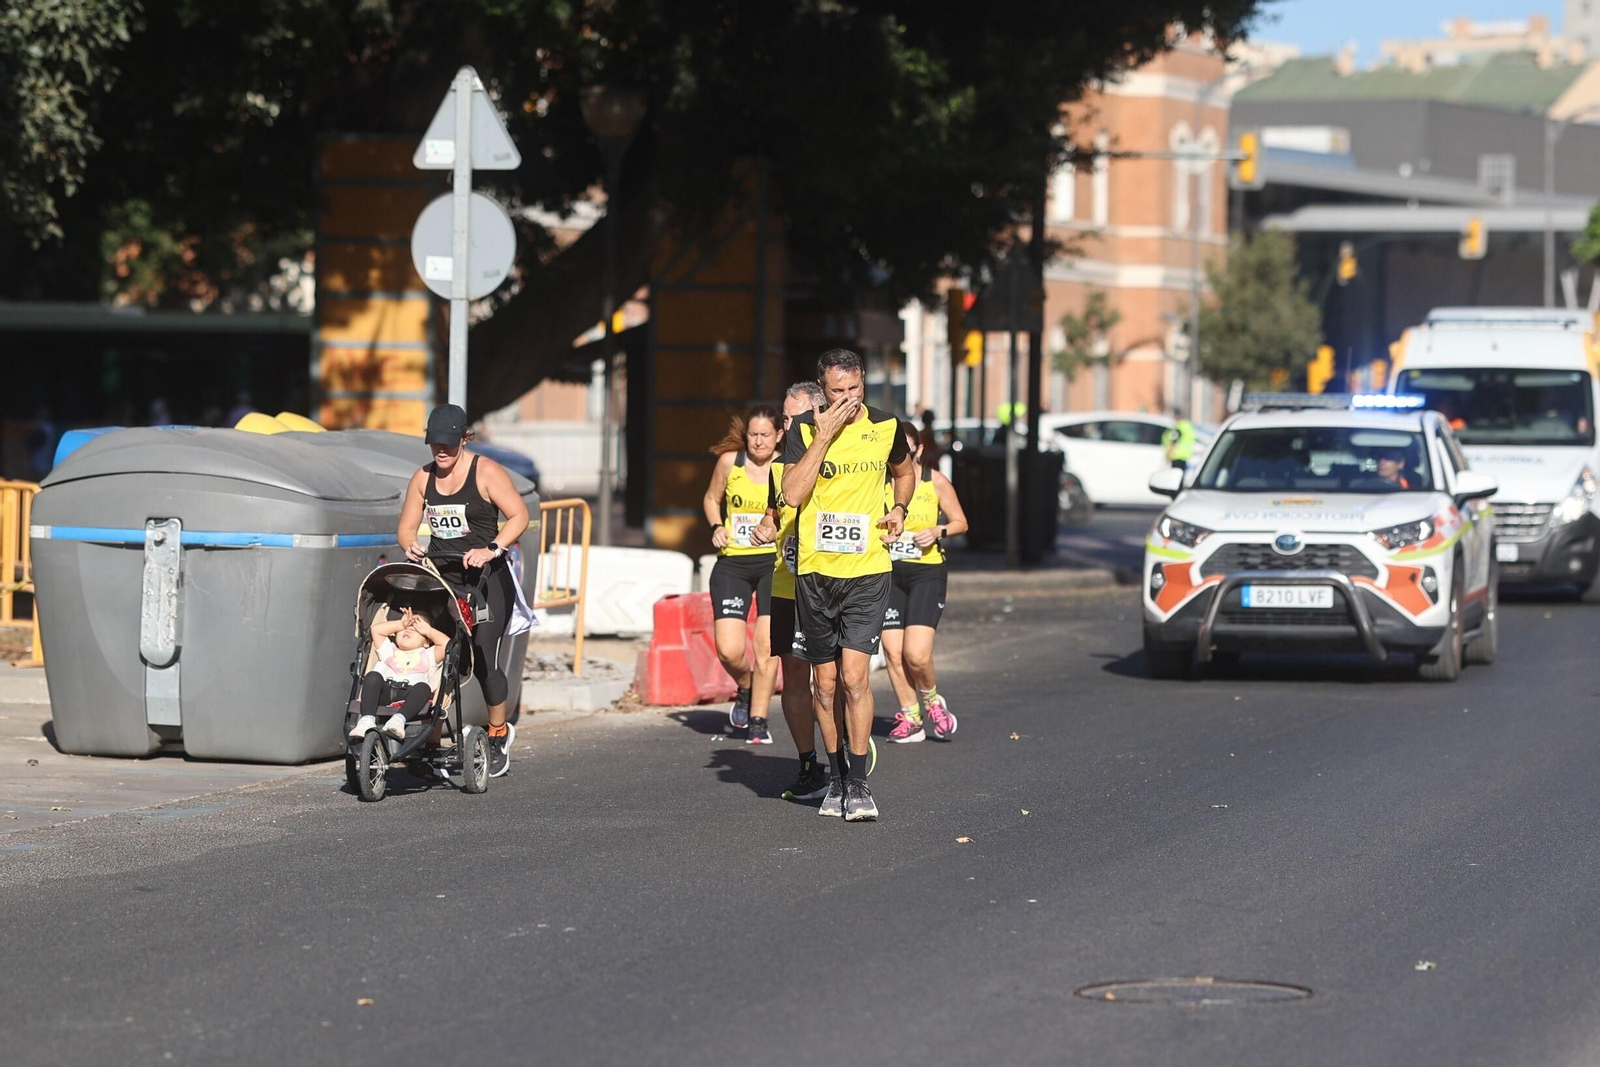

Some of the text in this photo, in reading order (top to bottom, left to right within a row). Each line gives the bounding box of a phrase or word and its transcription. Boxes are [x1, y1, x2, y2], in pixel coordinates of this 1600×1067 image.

[819, 460, 886, 479] AIRZONE
[430, 516, 462, 528] 640
[821, 525, 861, 541] 236
[1256, 590, 1294, 604] 8210
